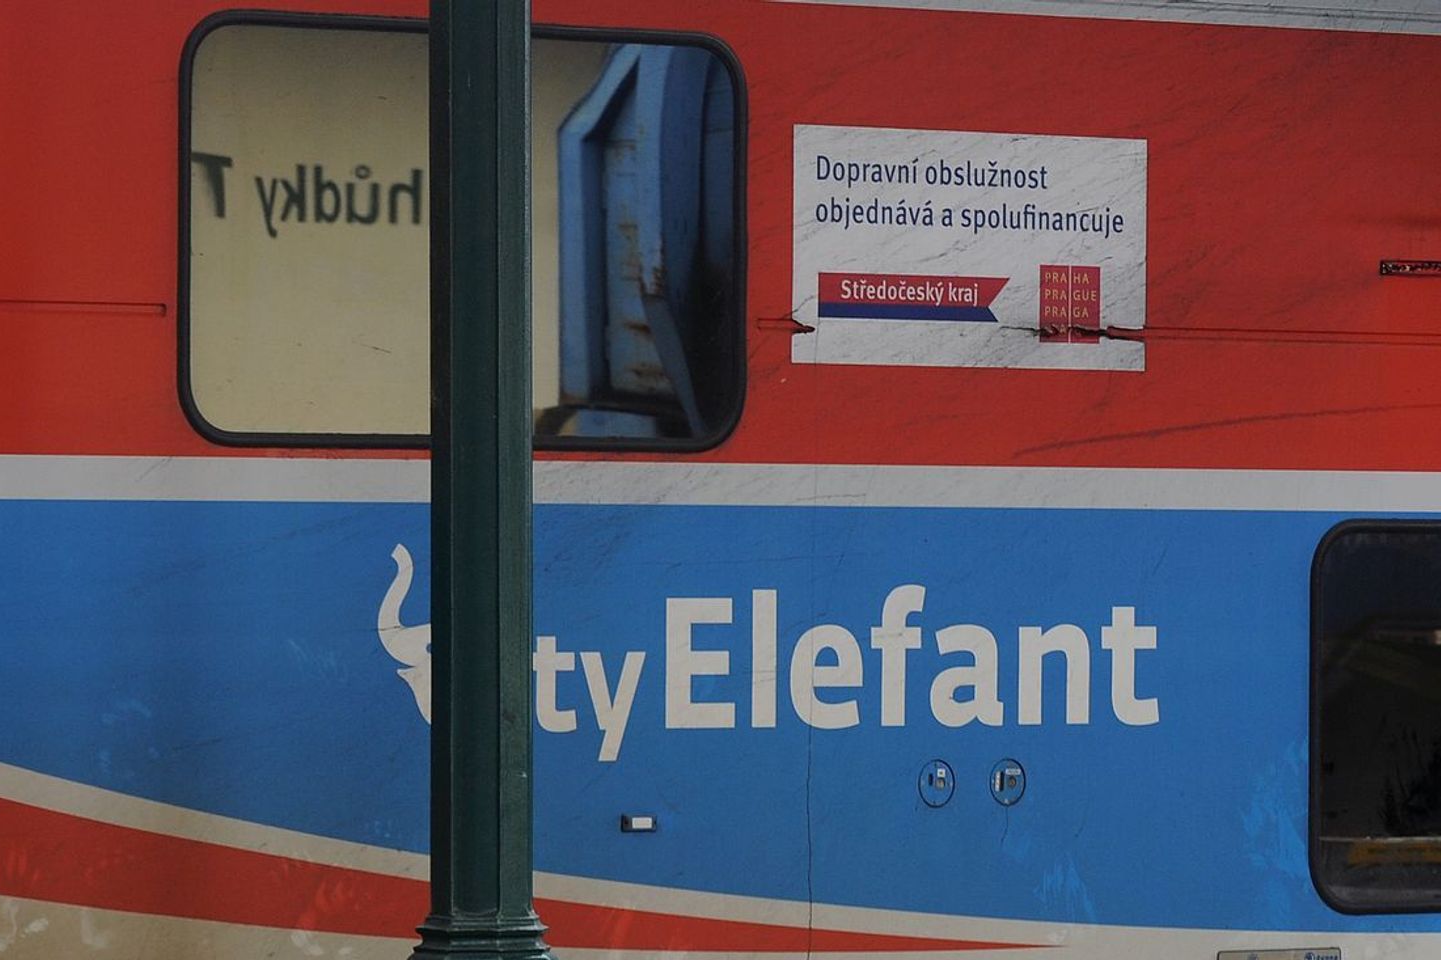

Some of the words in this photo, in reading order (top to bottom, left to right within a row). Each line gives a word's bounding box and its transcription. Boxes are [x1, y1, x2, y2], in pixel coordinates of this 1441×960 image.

[816, 155, 919, 188] Dopravní
[925, 159, 1048, 189] obslužnost
[815, 196, 933, 230] objednává
[941, 207, 953, 227] a
[961, 203, 1124, 239] spolufinancuje
[841, 279, 945, 306] Středočeský
[948, 282, 979, 307] kraj
